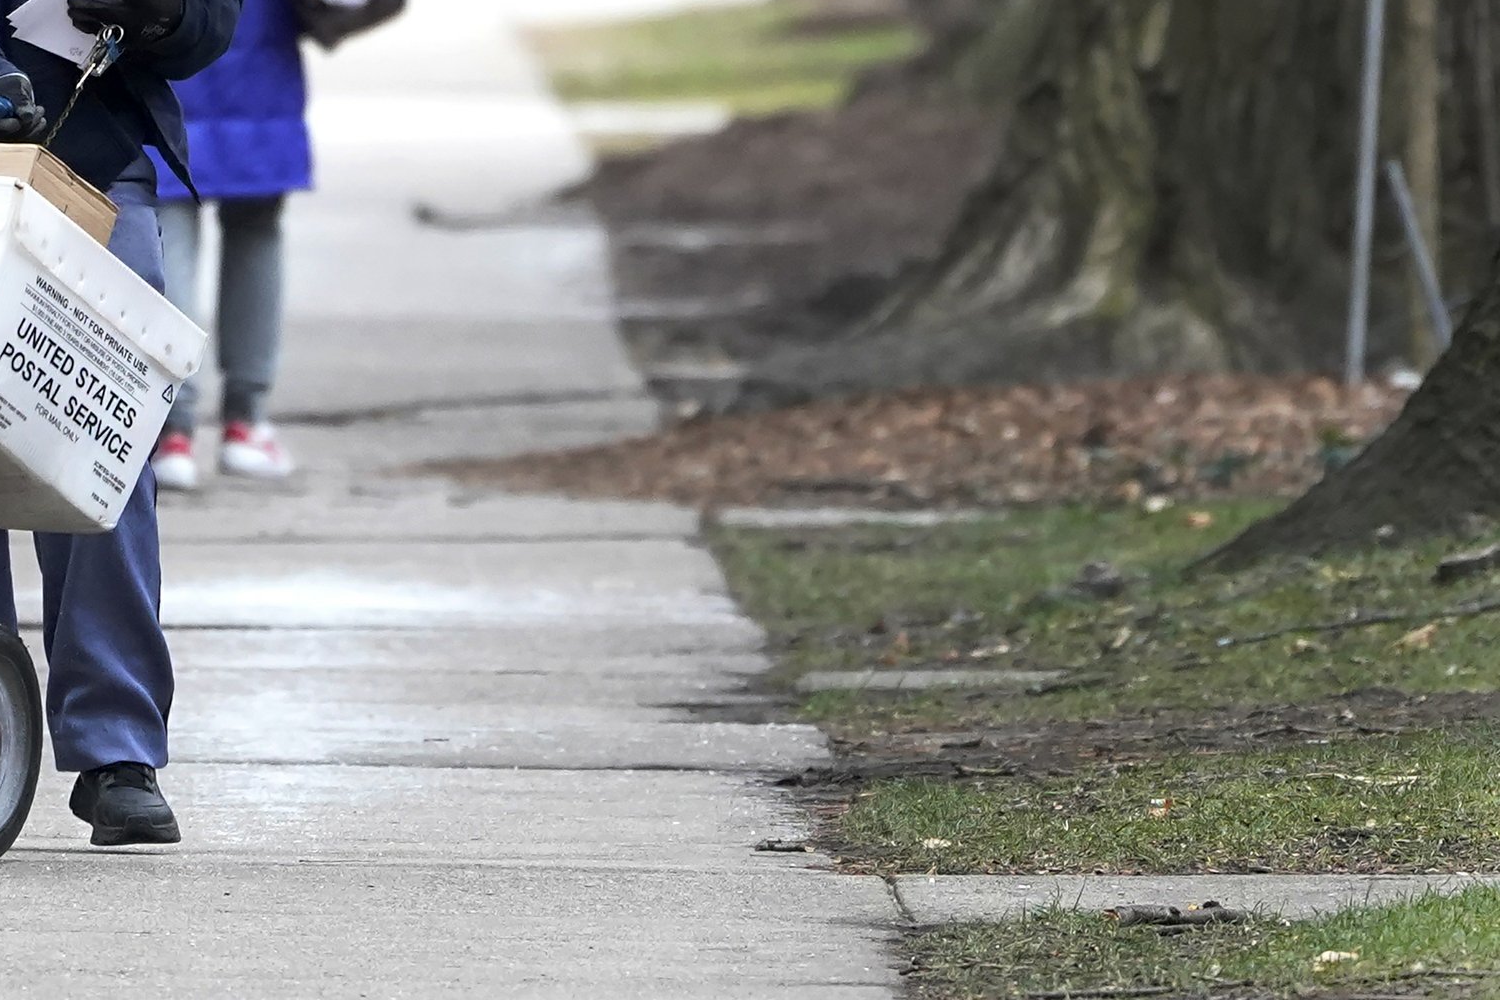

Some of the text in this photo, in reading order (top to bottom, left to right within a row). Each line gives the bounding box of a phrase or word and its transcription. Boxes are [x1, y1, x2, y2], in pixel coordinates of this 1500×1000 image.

[17, 317, 75, 376] UNITED
[75, 367, 137, 429] STATES
[36, 275, 69, 309] WARNING
[73, 307, 89, 323] NOT
[88, 322, 104, 338] FOR
[104, 333, 133, 362] PRIVATE
[133, 358, 149, 376] USE
[0, 342, 61, 407] POSTAL
[64, 396, 133, 464] SERVICE
[35, 402, 80, 443] FOR MAIL ONLY
